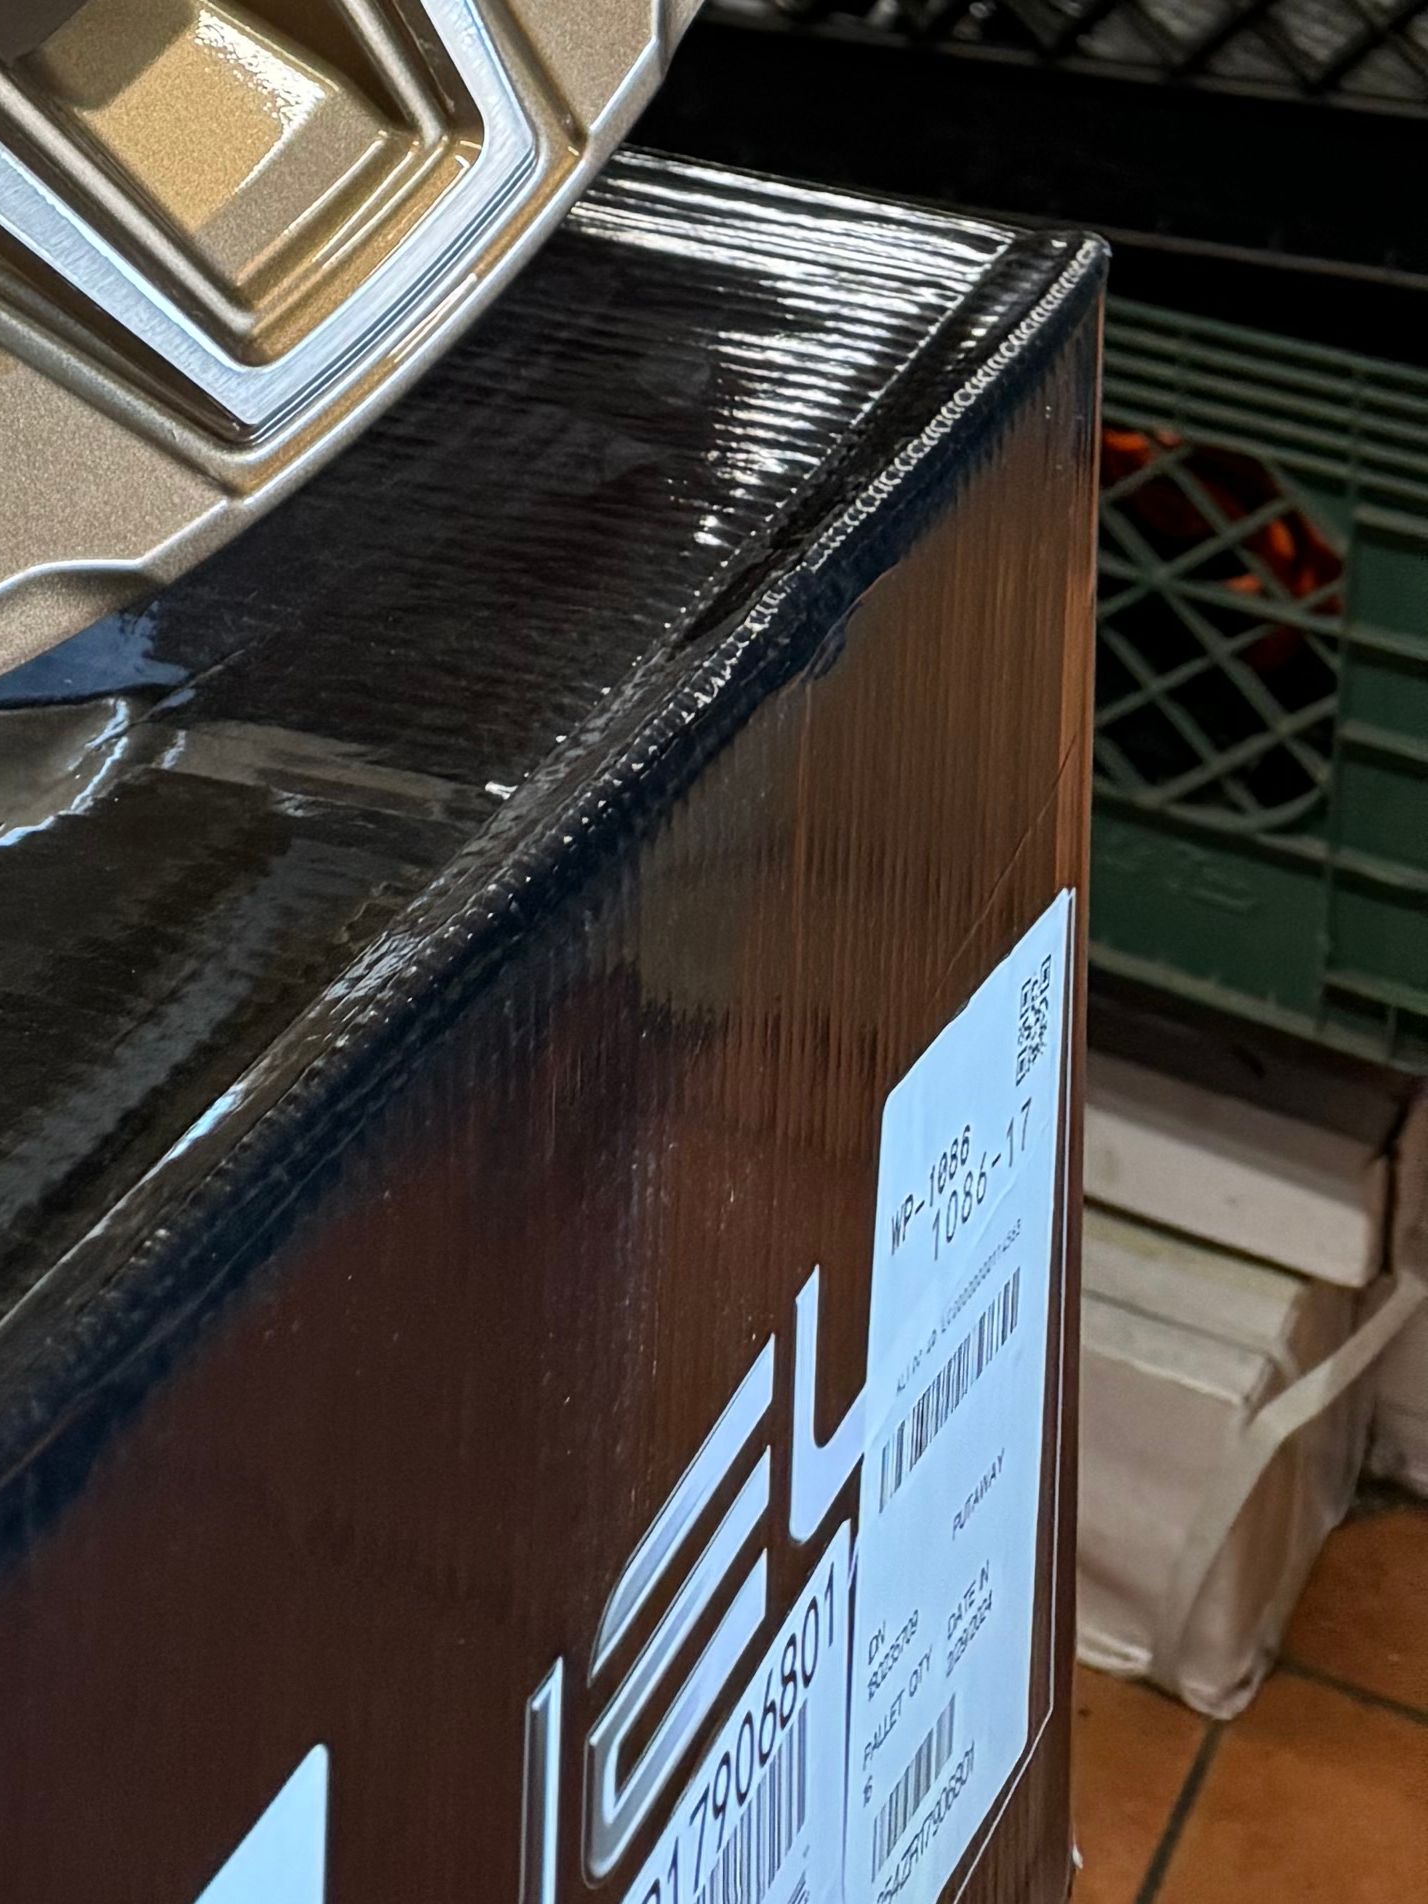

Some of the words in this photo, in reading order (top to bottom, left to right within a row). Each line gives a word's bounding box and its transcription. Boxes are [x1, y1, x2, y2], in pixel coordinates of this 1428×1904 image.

[890, 1124, 971, 1256] WP-1086
[931, 1096, 1033, 1261] 1086-17
[952, 1447, 1005, 1541] PUTAWAY
[947, 1579, 977, 1641] DATE
[862, 1687, 906, 1772] PALLET
[908, 1643, 933, 1698] QTY
